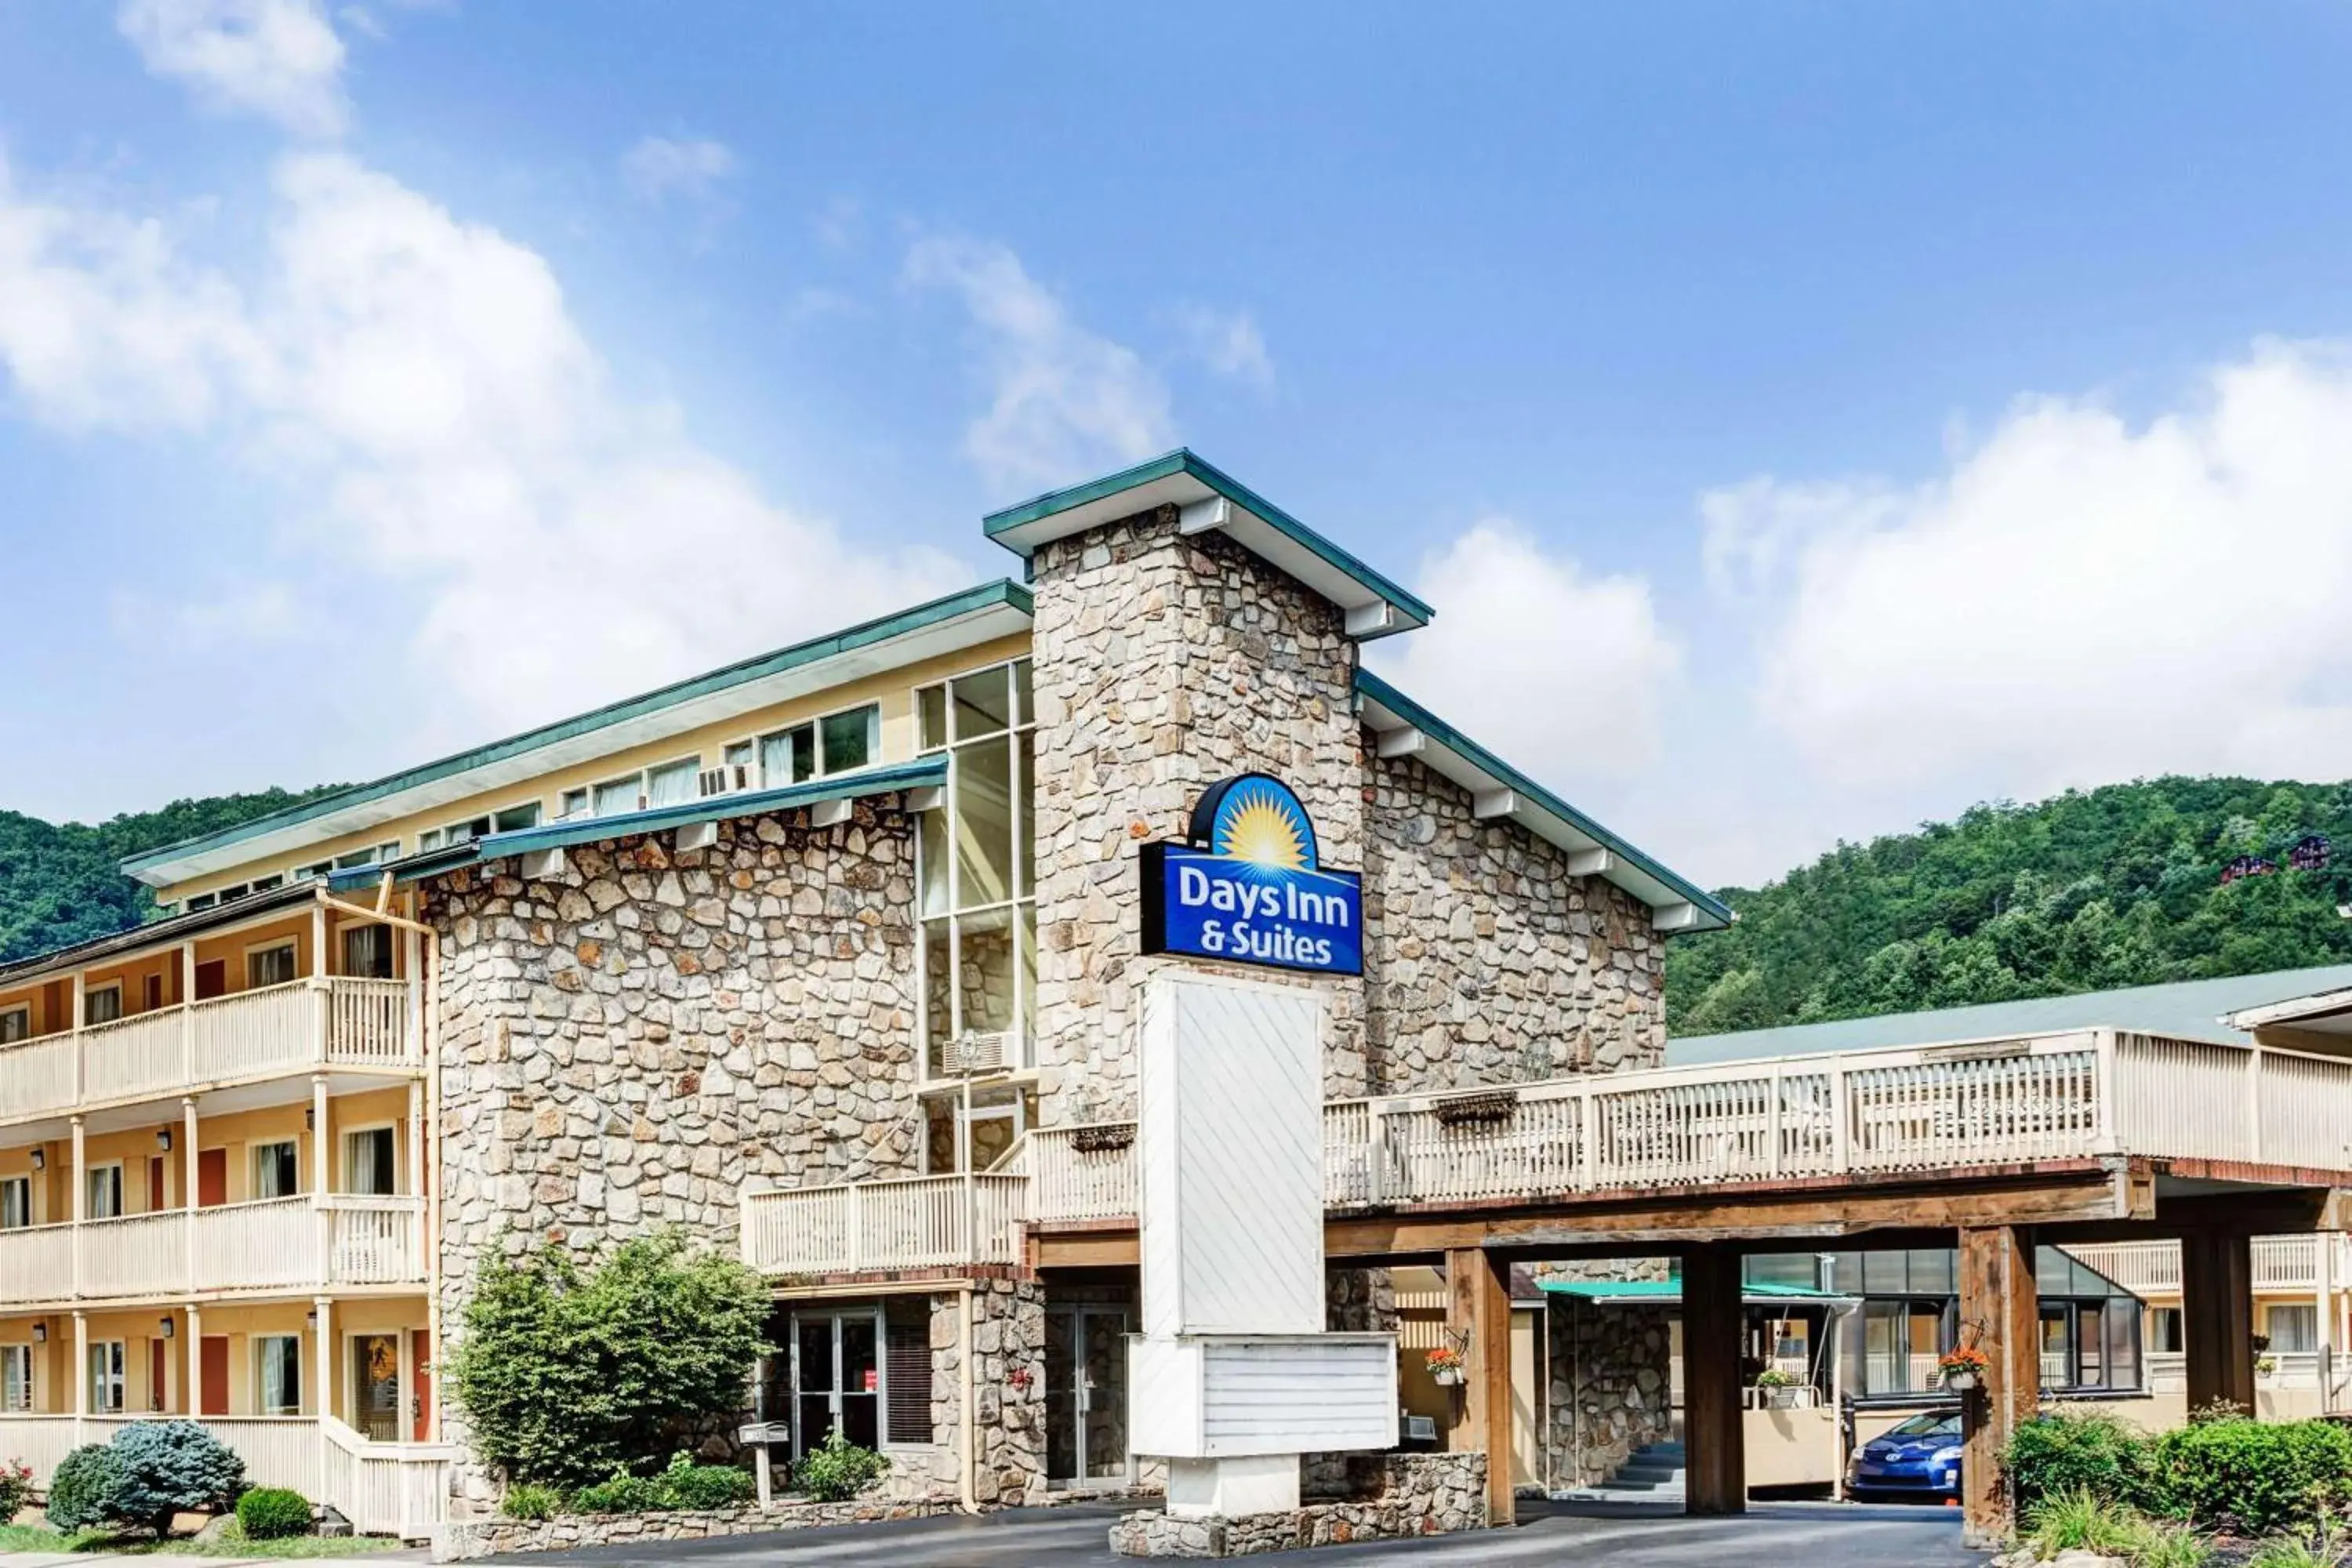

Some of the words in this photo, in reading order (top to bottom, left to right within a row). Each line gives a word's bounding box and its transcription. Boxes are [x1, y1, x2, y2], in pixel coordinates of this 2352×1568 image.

[1180, 866, 1280, 920] Days
[1287, 882, 1348, 927] Inn
[1201, 920, 1225, 951] &
[1232, 921, 1331, 964] Suites
